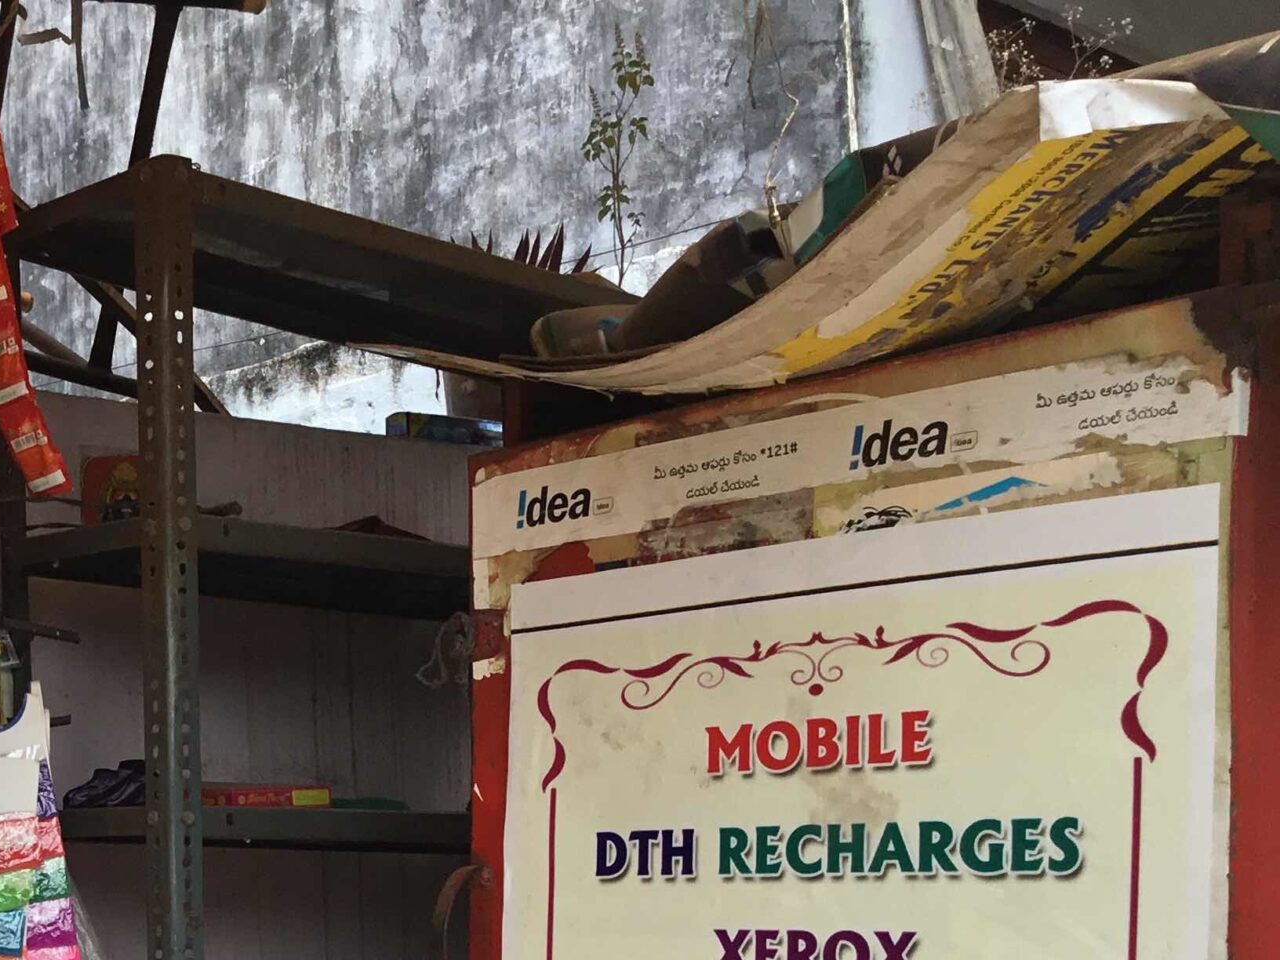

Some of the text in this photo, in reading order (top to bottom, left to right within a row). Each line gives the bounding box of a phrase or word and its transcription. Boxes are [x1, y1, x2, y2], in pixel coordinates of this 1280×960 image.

[705, 709, 934, 777] MOBILE
[594, 815, 1086, 878] DTH RECHARGES
